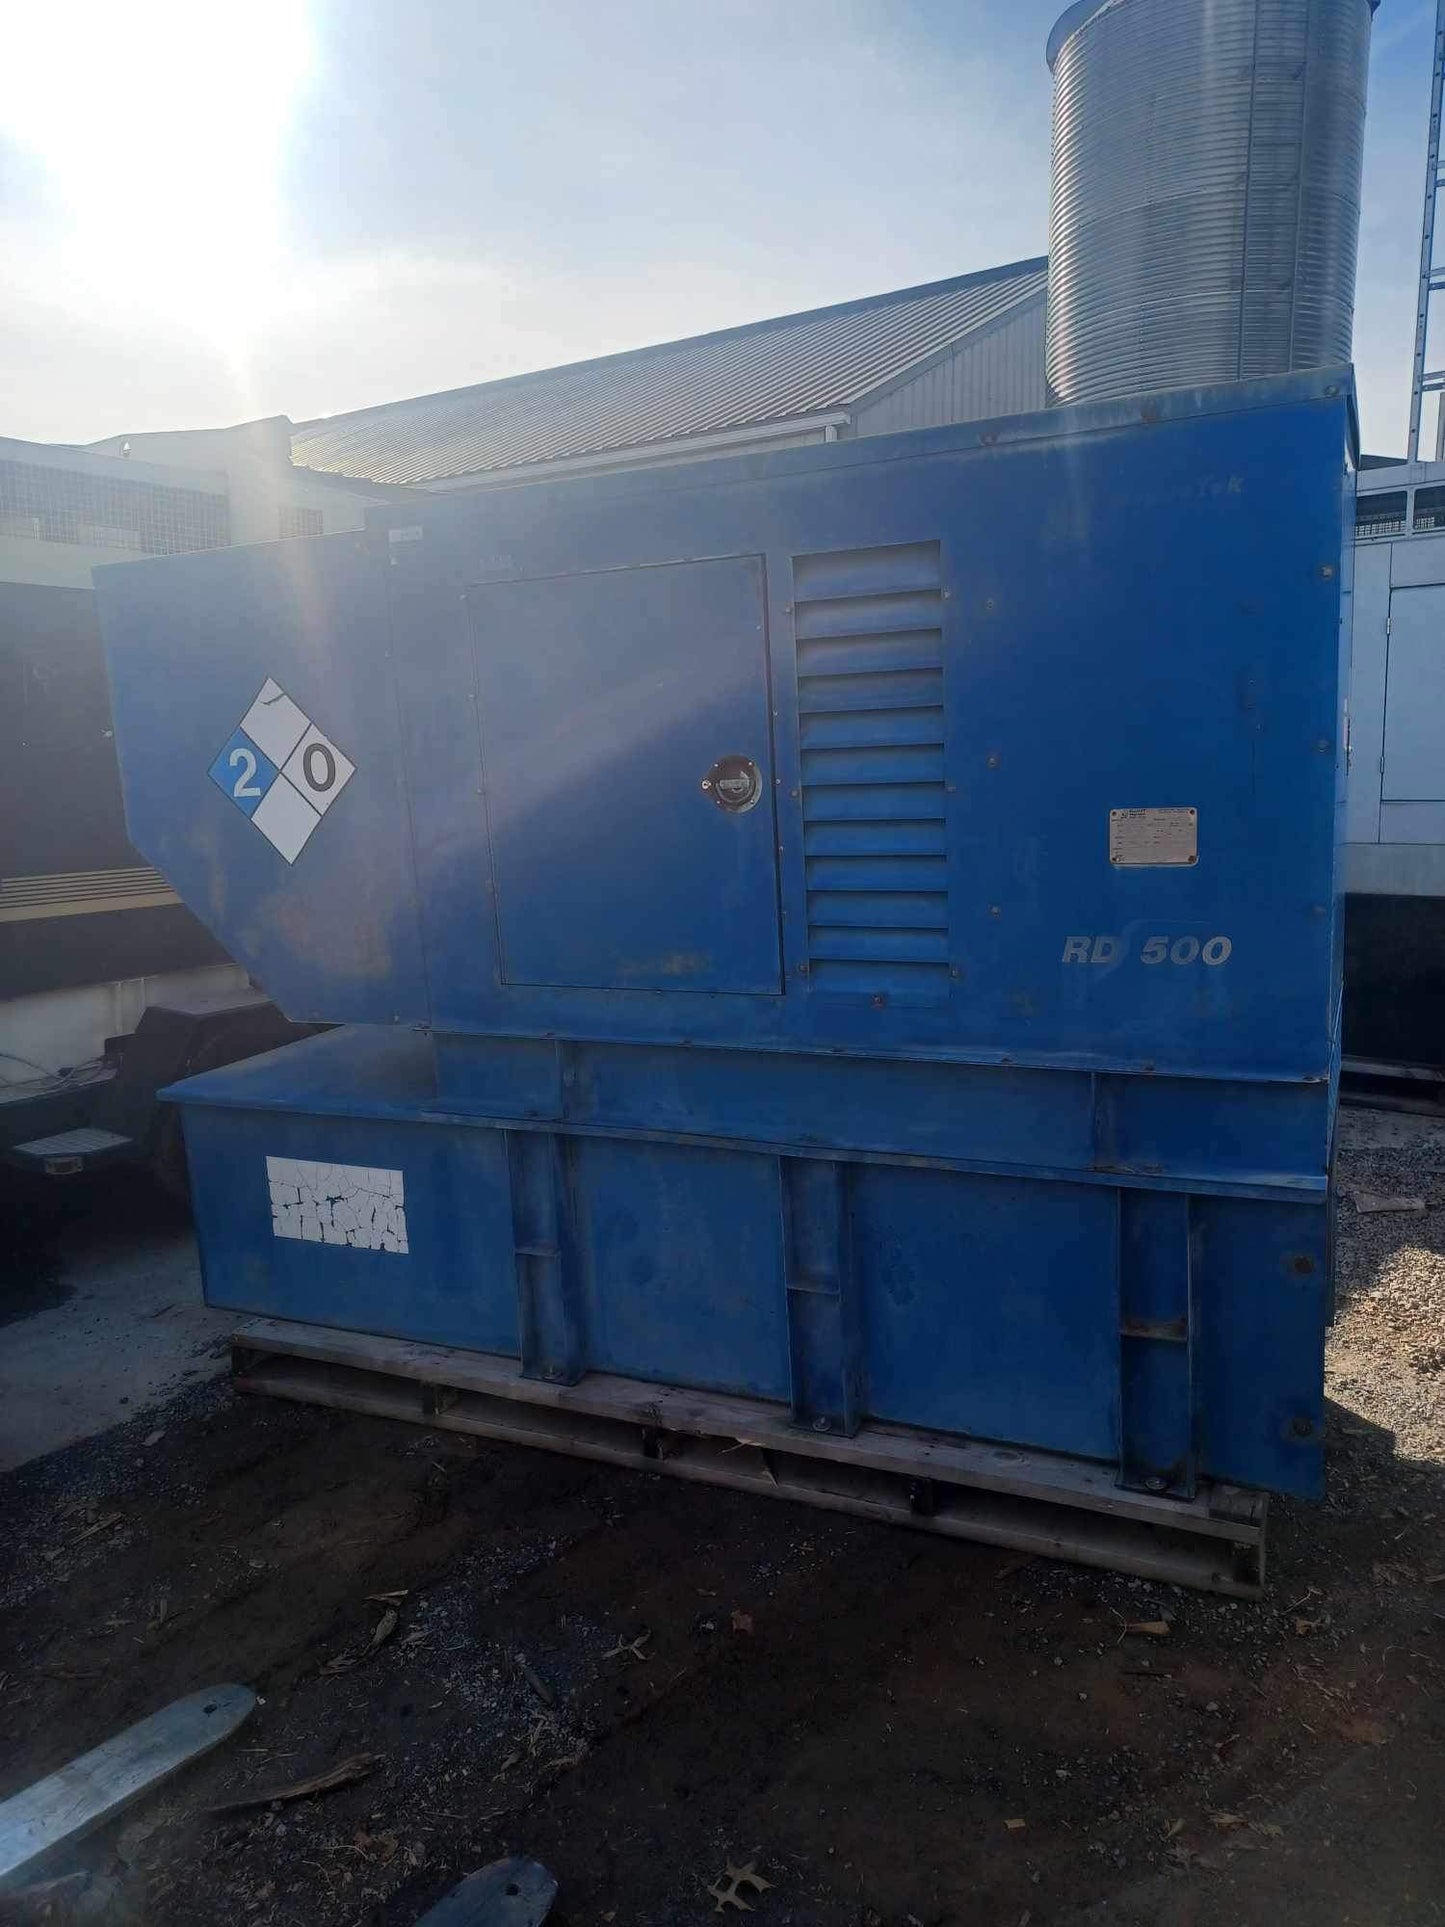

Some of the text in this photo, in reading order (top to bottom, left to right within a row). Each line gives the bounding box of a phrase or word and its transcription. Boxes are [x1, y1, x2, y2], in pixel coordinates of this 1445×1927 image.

[229, 742, 336, 798] 2 0
[1061, 935, 1233, 966] RD 500
